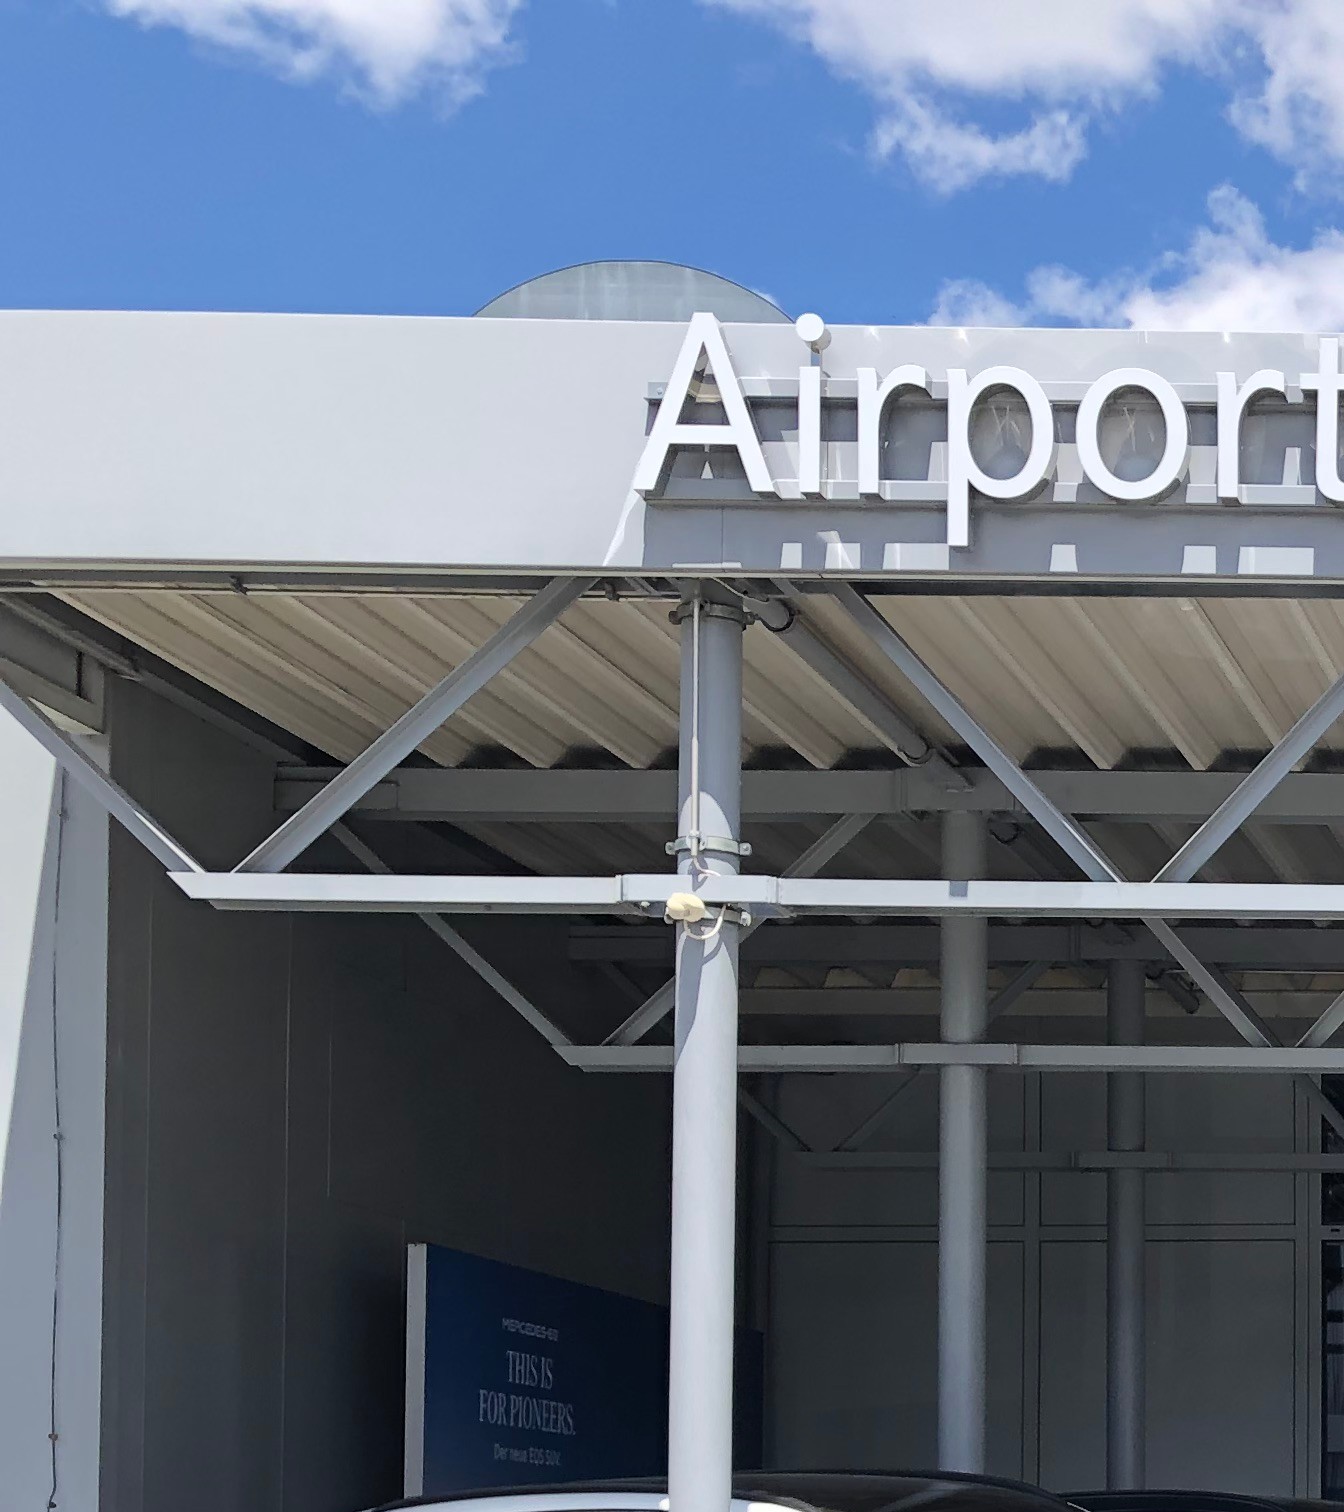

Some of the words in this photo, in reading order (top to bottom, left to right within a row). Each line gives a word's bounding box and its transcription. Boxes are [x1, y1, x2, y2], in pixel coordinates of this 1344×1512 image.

[506, 1350, 538, 1387] THIS
[541, 1357, 553, 1390] IS
[478, 1389, 507, 1426] FOR
[510, 1394, 577, 1437] PIONEERS.
